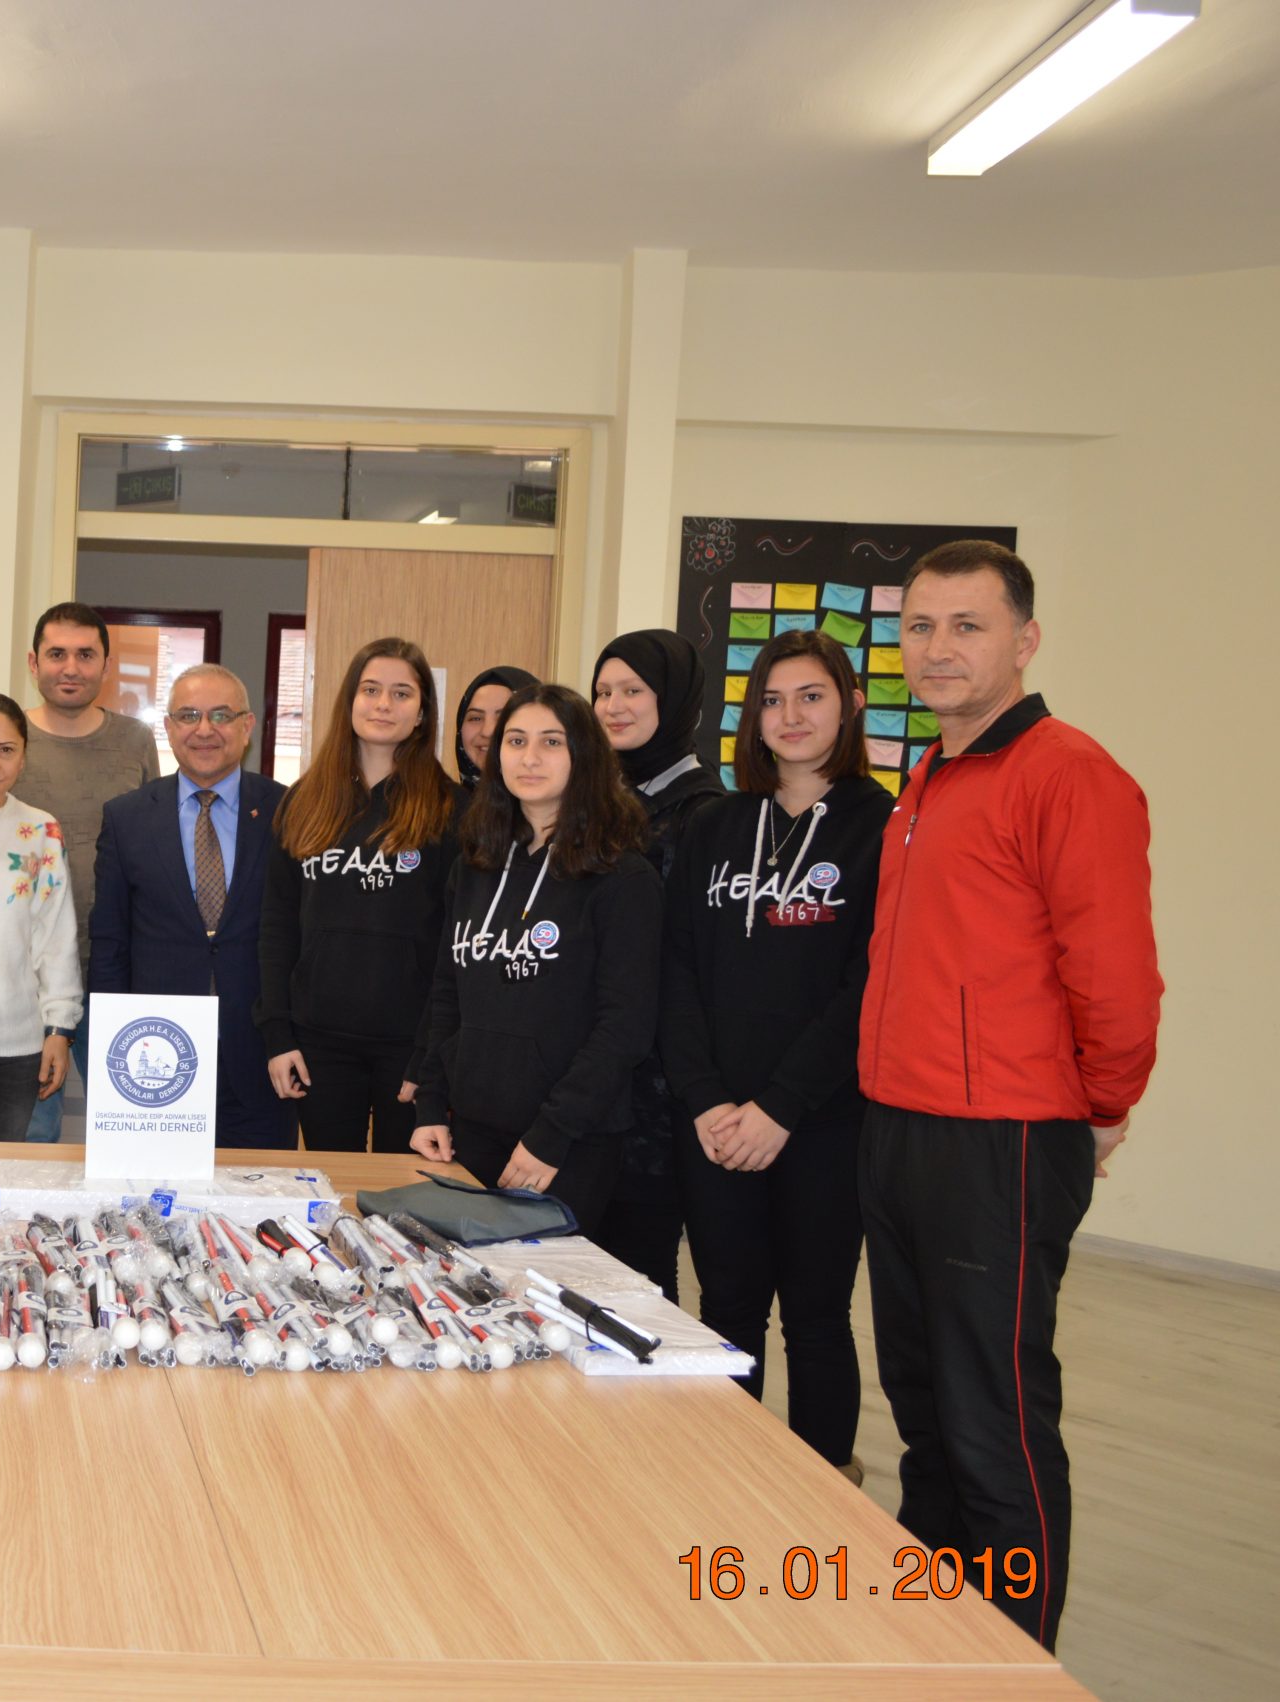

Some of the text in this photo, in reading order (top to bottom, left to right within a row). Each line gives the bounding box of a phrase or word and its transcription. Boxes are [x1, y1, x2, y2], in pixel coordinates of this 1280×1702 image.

[360, 872, 394, 891] 1967
[505, 960, 539, 980] 1967
[119, 1025, 149, 1051] ÜSKÜDAR
[115, 1060, 190, 1070] 19 96
[118, 1074, 186, 1100] MEZUNLARI DERNEĞİ
[95, 1121, 207, 1133] MEZUNLARI DERNEĞİ
